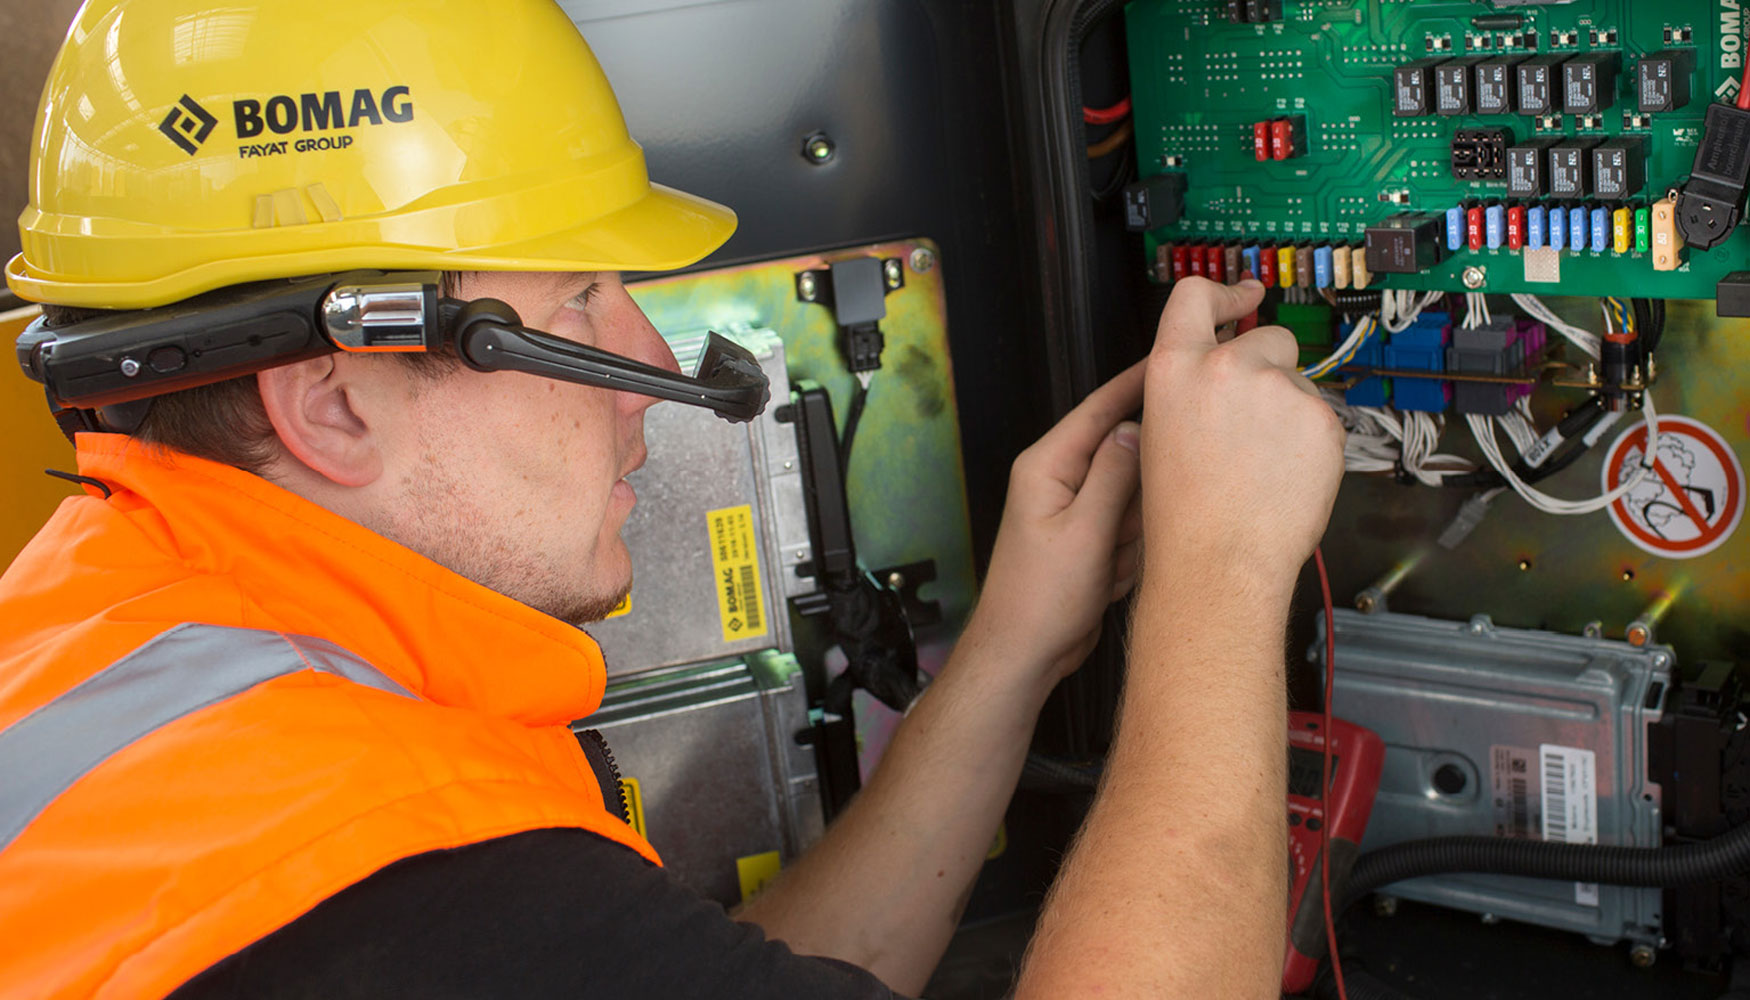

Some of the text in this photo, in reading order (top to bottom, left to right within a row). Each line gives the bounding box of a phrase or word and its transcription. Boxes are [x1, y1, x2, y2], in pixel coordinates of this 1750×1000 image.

[233, 85, 415, 140] BOMAG
[239, 134, 354, 159] FAYAT GROUP
[1449, 225, 1457, 236] 15
[1469, 225, 1477, 236] 10
[1508, 225, 1517, 236] 10
[1530, 225, 1539, 235] 15
[1552, 225, 1560, 236] 15
[1572, 225, 1581, 236] 15
[1593, 226, 1602, 237] 15
[1656, 232, 1667, 245] 60
[723, 568, 737, 613] BOMAG
